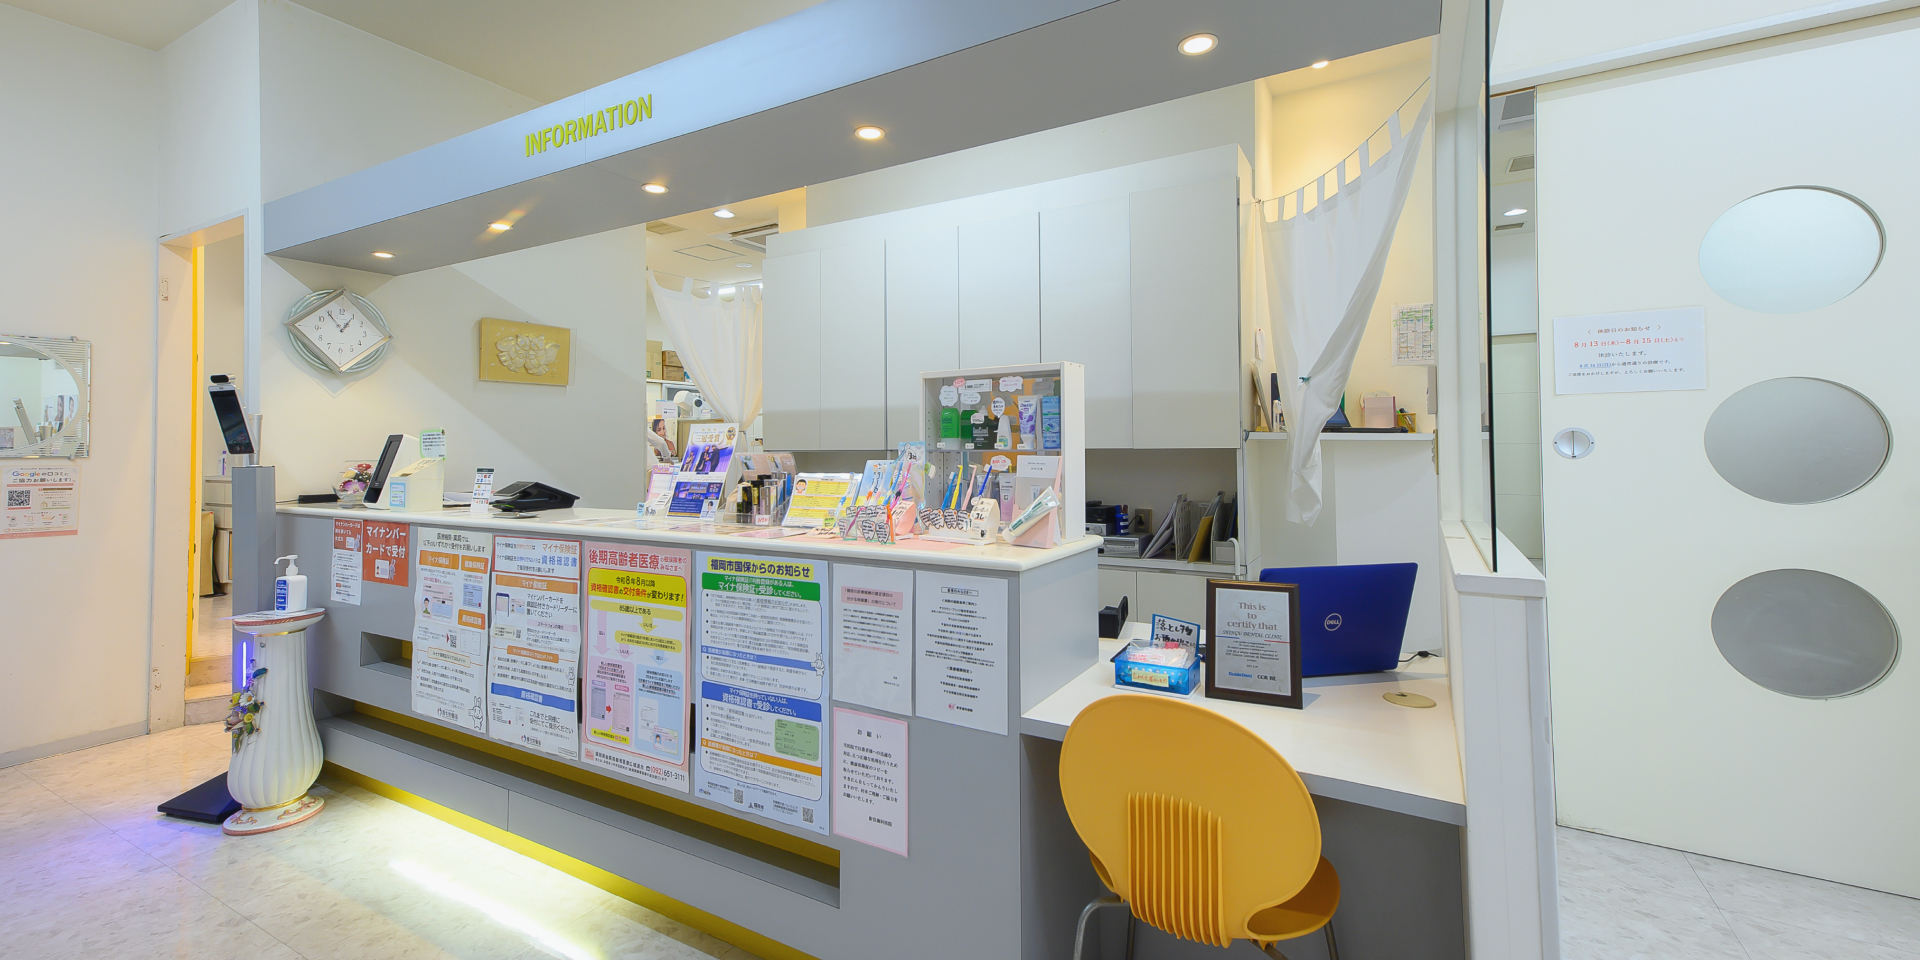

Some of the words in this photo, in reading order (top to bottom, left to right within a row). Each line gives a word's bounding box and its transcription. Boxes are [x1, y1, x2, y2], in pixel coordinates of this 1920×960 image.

[525, 93, 652, 157] INFORMATION
[1598, 326, 1650, 334] 休診日のお知らせ
[366, 526, 406, 539] マイナンバー
[366, 543, 406, 558] カードで受付
[542, 543, 577, 554] マイナ保険証
[428, 556, 449, 565] マイナ保険証
[541, 555, 577, 567] 資格確認書
[588, 549, 659, 570] 後期高齢者医療
[711, 559, 810, 578] 福岡市国保からのお知らせ
[522, 580, 547, 589] マイナ保険証
[616, 576, 656, 587] 令和8年8月以降
[590, 583, 684, 602] 資格確認書の交付条件が変わります!
[718, 582, 802, 598] マイナ保険証で受診してください。
[527, 594, 563, 604] マイナンバーカードを
[1238, 602, 1257, 610] This
[1156, 619, 1193, 636] 落とし物
[1227, 621, 1257, 630] certify
[1258, 622, 1277, 630] that
[722, 693, 796, 716] 資格確認書で受診してください。
[858, 729, 882, 739] お願い
